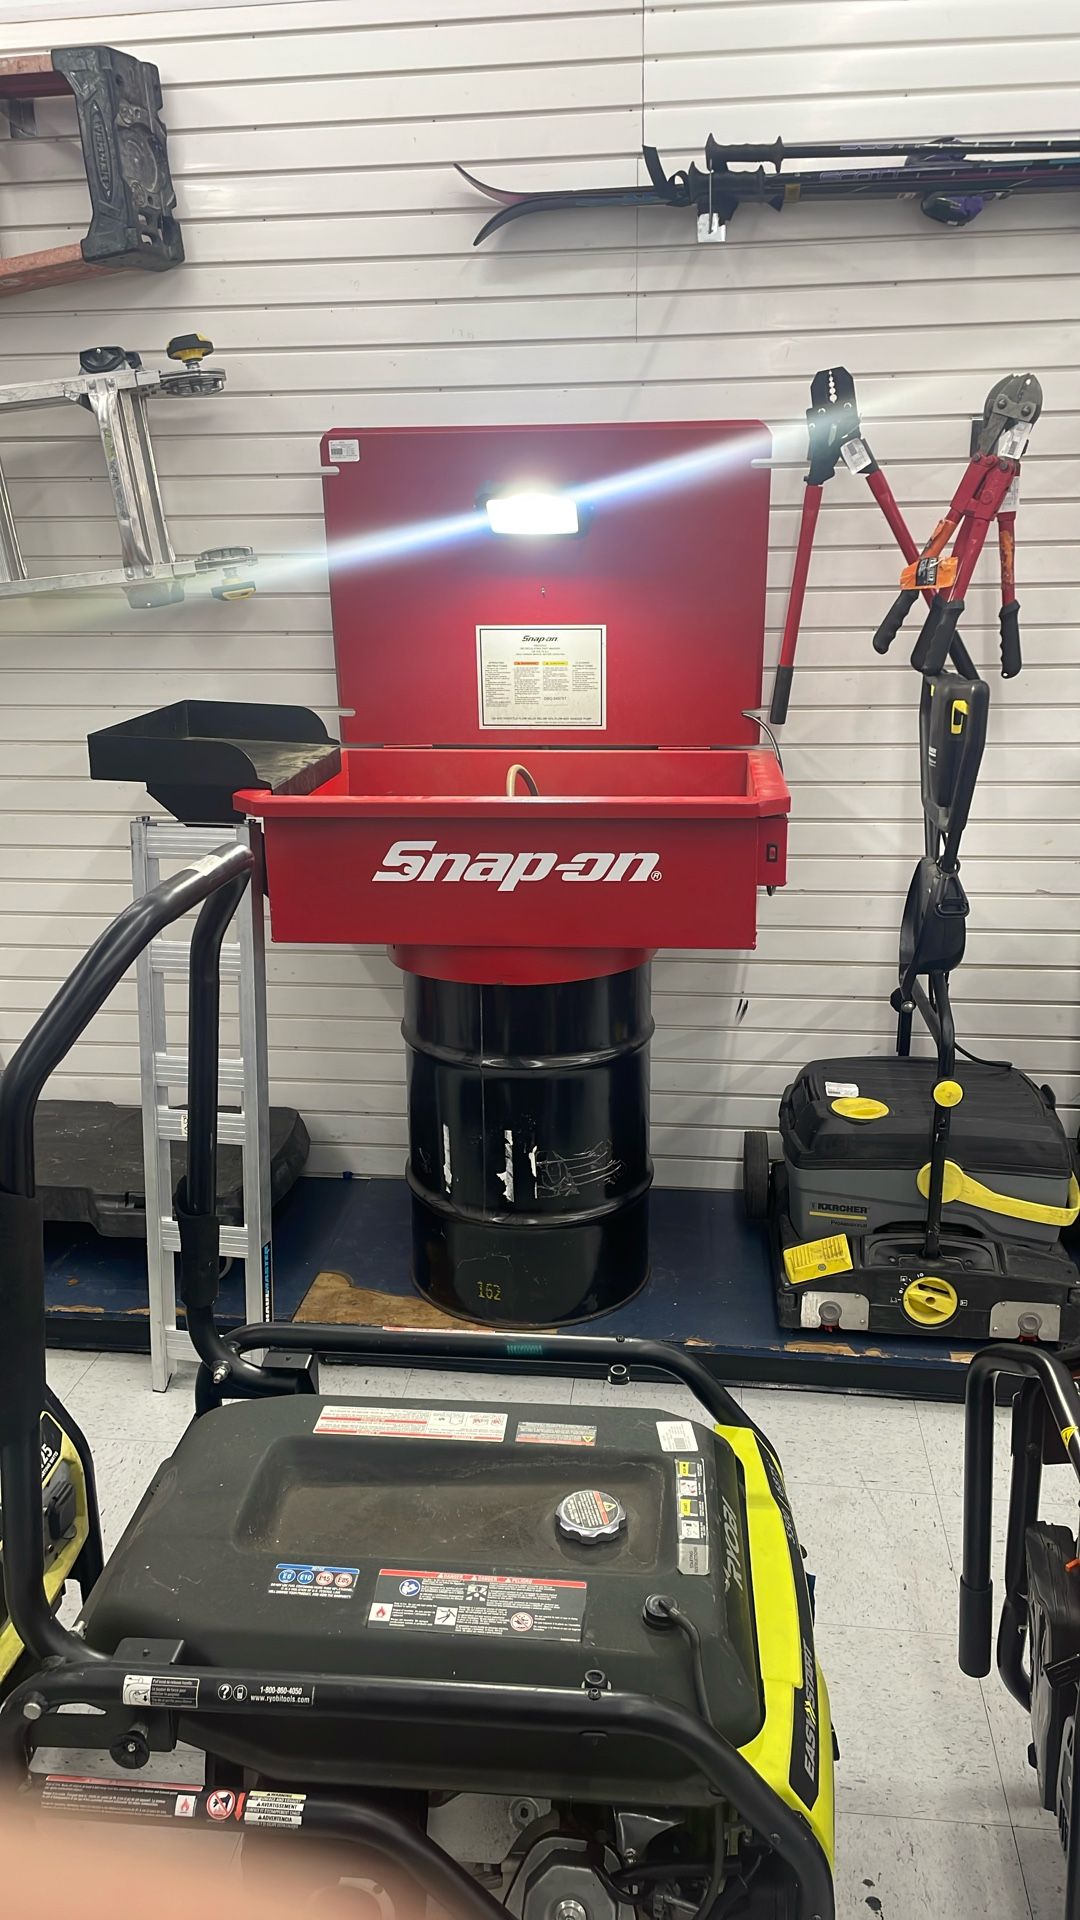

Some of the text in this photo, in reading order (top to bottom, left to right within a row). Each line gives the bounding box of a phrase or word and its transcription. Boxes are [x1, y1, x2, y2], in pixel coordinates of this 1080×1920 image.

[521, 635, 558, 643] Snap-on
[372, 840, 660, 892] Snap-on
[477, 1281, 501, 1300] 162
[721, 1495, 744, 1593] RYOBI
[250, 1695, 310, 1703] www.ryobitools.com
[802, 1637, 818, 1783] EASY START
